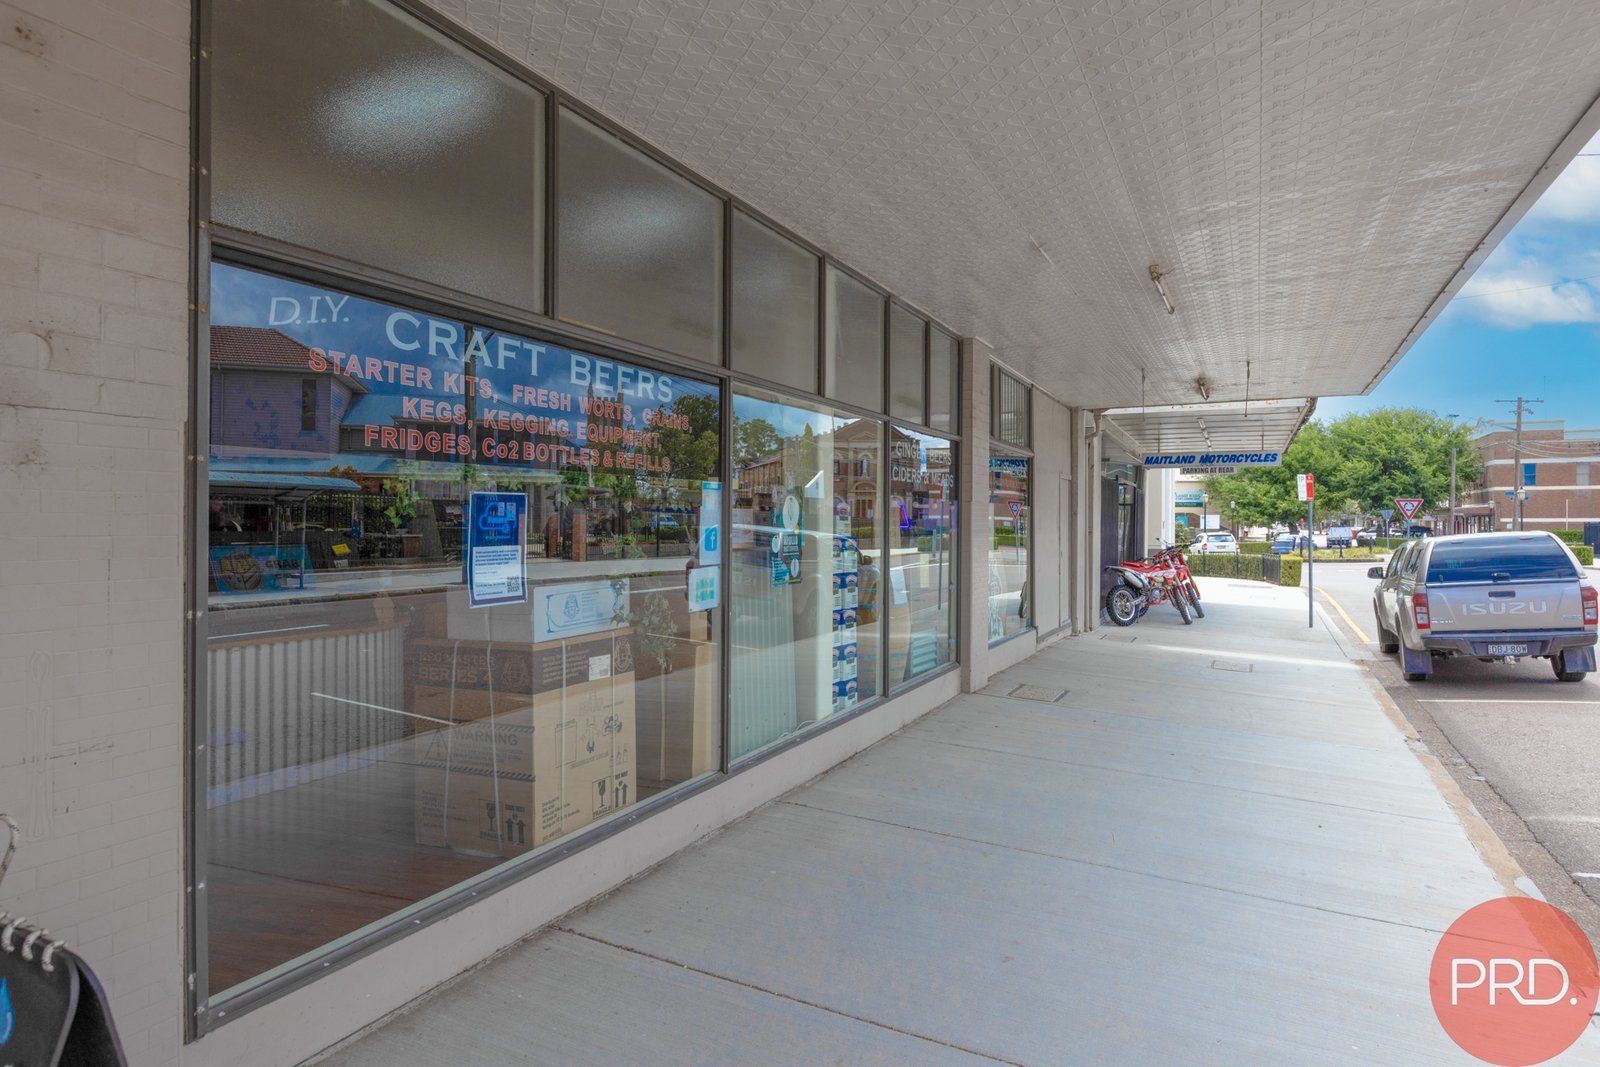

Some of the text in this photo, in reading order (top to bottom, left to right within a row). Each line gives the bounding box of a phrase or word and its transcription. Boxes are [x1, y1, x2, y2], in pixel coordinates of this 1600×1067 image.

[268, 295, 350, 326] D.I.Y.
[386, 311, 673, 403] CRAFT BEERS
[308, 347, 433, 390] STARTER
[443, 371, 498, 404] KITS,
[512, 384, 571, 412] FRESH
[578, 395, 636, 424] WORTS,
[402, 396, 473, 431] KEGS,
[364, 424, 671, 473] FRIDGES, Co2 BOTTLES & REFILLS
[895, 441, 926, 460] GINGE
[1144, 453, 1278, 465] MAITLAND MOTORCYCLES
[892, 466, 922, 483] CIDERS
[924, 472, 930, 485] &
[1182, 466, 1209, 474] PARKING
[1209, 466, 1218, 474] AT
[1461, 600, 1548, 616] ISUZU
[418, 666, 478, 683] SERIES
[453, 728, 519, 746] WARNING
